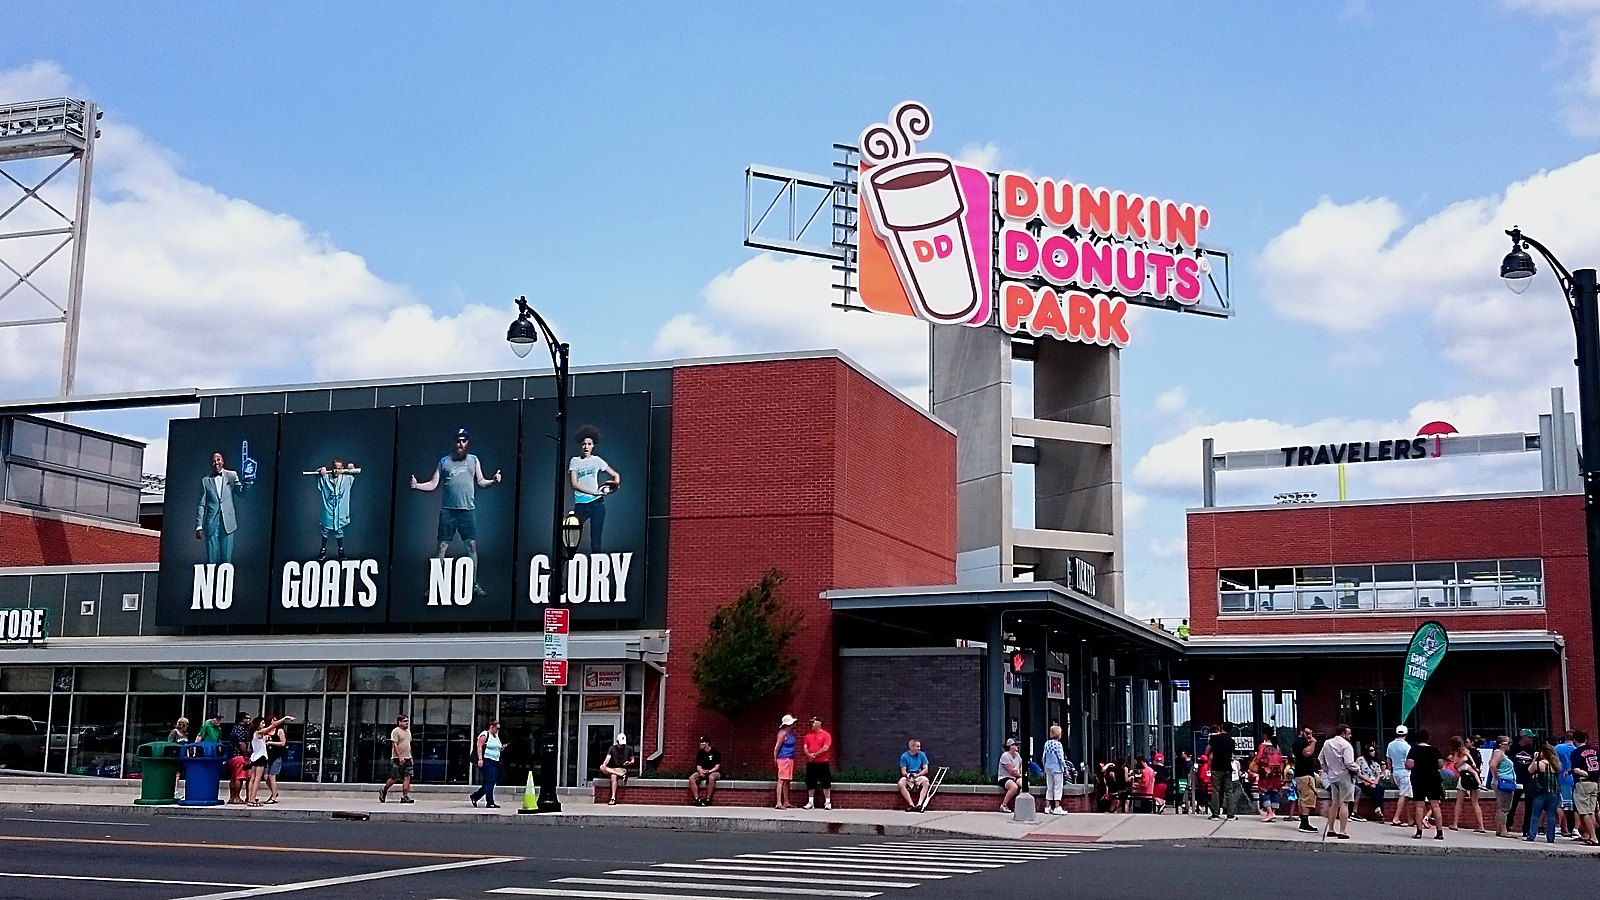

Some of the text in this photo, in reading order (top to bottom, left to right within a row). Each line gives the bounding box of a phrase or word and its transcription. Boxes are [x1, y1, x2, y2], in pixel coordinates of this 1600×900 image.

[1004, 173, 1209, 248] DUNKIN'
[912, 234, 953, 263] DD
[1004, 229, 1201, 300] DONUTS
[1004, 284, 1130, 344] PARK
[1281, 438, 1426, 467] TRAVELERS
[190, 552, 633, 610] NO GOATS NO GORY
